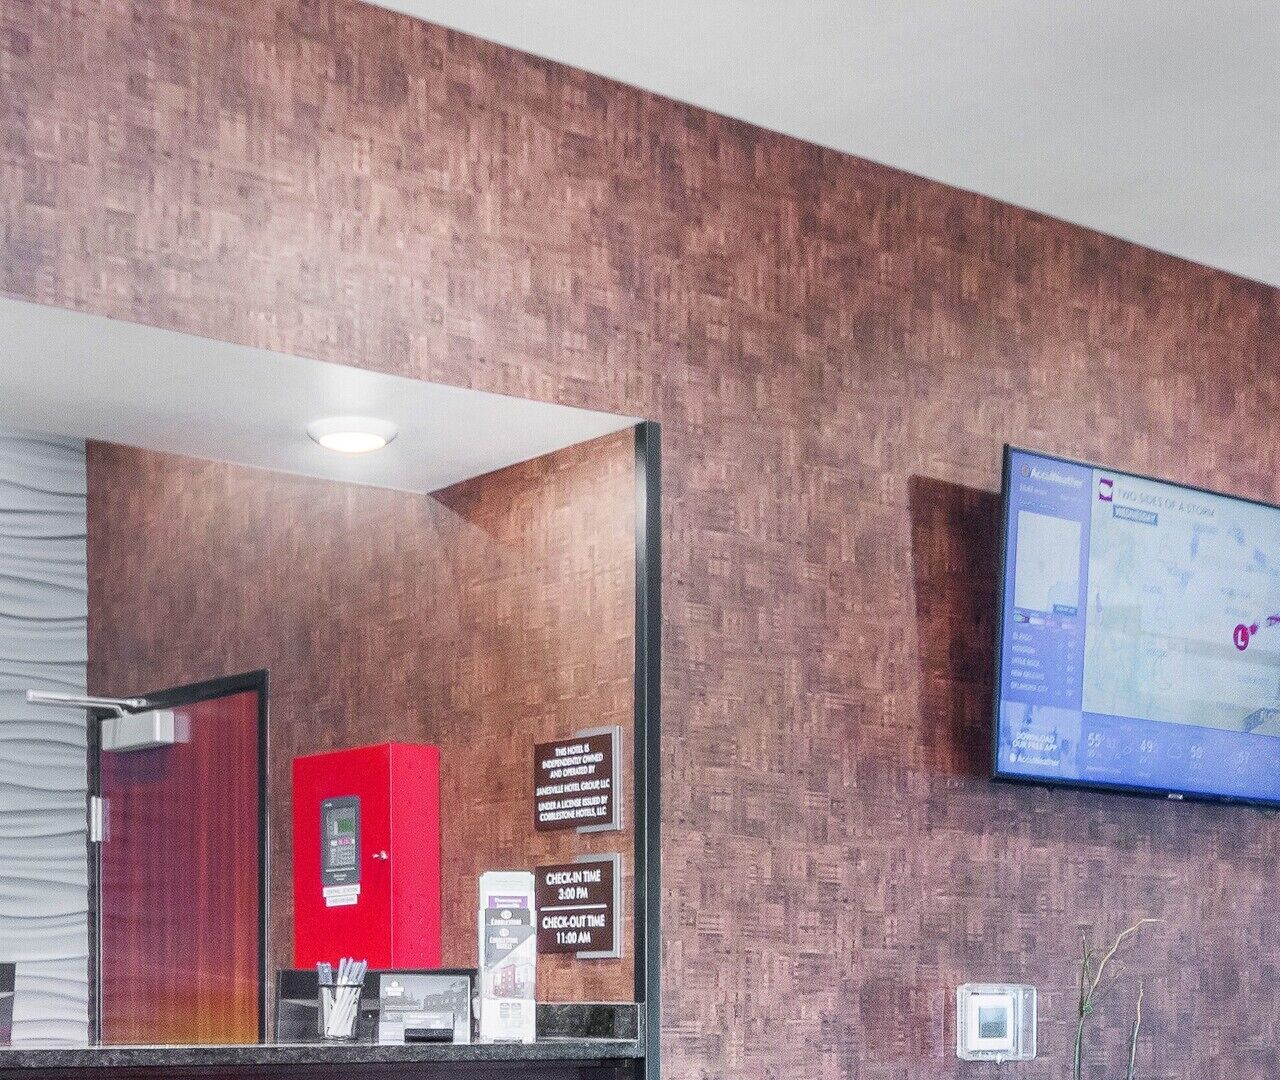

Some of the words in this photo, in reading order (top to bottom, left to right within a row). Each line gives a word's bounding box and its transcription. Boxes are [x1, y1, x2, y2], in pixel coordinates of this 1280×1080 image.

[555, 746, 567, 757] THIS
[567, 744, 583, 755] HOTEL
[584, 743, 590, 753] IS
[542, 756, 582, 769] INDEPENDENTLY
[582, 752, 604, 763] OWNED
[550, 769, 562, 779] AND
[562, 766, 588, 777] OPERATED
[588, 764, 596, 774] BY
[536, 784, 564, 797] JANESVILLE
[564, 782, 580, 792] HOTEL
[600, 778, 610, 788] LLC
[538, 800, 556, 811] UNDER
[556, 800, 561, 810] A
[562, 798, 582, 809] LICENSE
[582, 796, 600, 807] ISSUED
[601, 795, 609, 805] BY
[540, 809, 575, 822] COBBLESTONE
[575, 807, 597, 818] HOTELS,
[597, 805, 607, 816] LLC
[546, 871, 582, 886] CHECK-IN
[583, 869, 601, 883] TIME
[558, 887, 576, 900] 3:00
[576, 887, 589, 899] PM
[542, 914, 586, 929] CHECK-OUT
[587, 913, 606, 927] TIME
[556, 931, 577, 944] 11:00
[577, 930, 592, 944] AM
